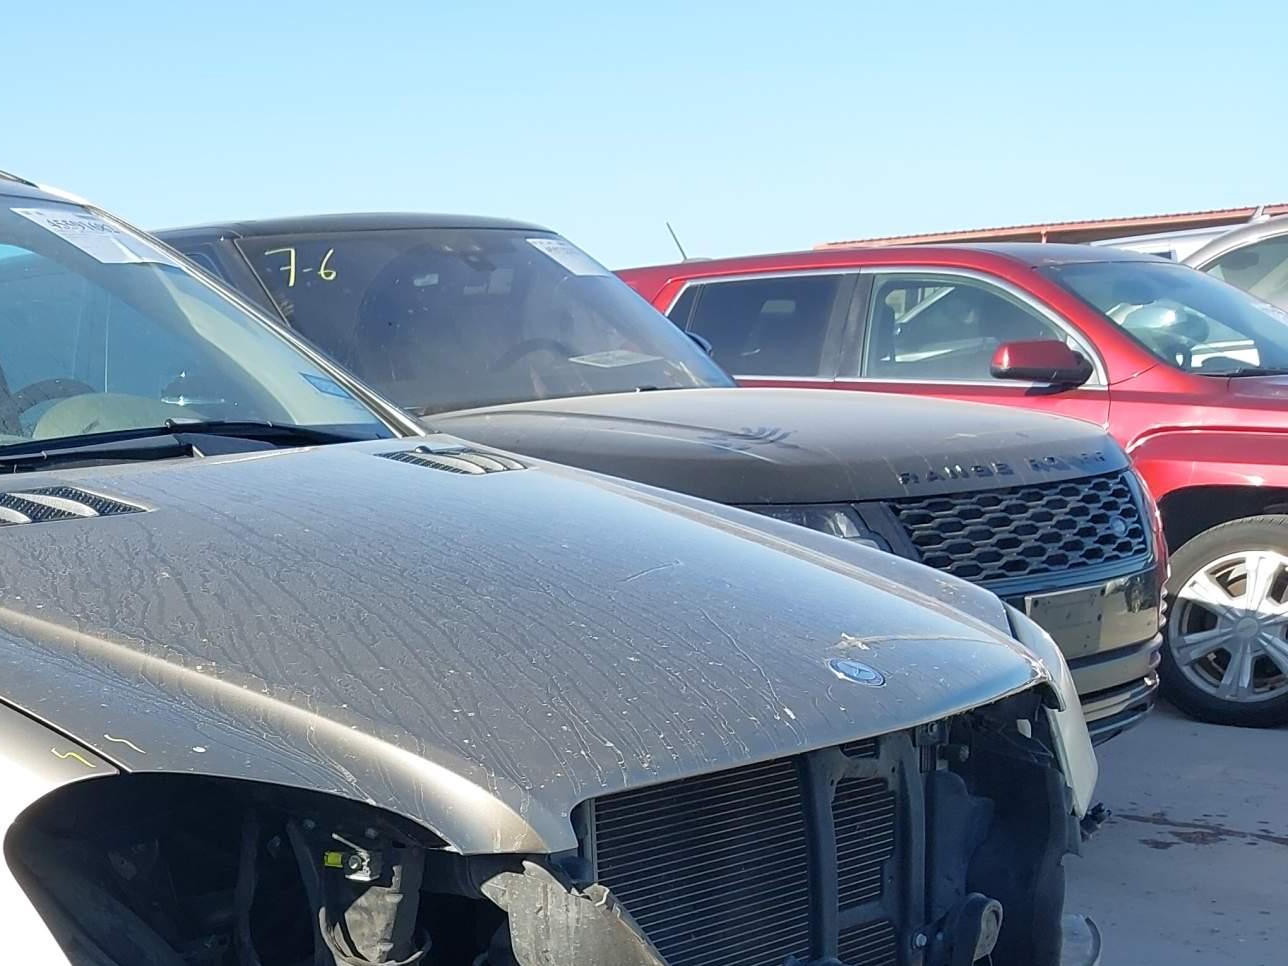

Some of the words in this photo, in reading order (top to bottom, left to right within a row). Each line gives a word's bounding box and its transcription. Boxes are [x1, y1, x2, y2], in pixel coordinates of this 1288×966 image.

[264, 247, 337, 287] 7-6
[898, 461, 1013, 485] RANGE
[1026, 450, 1106, 472] ROER
